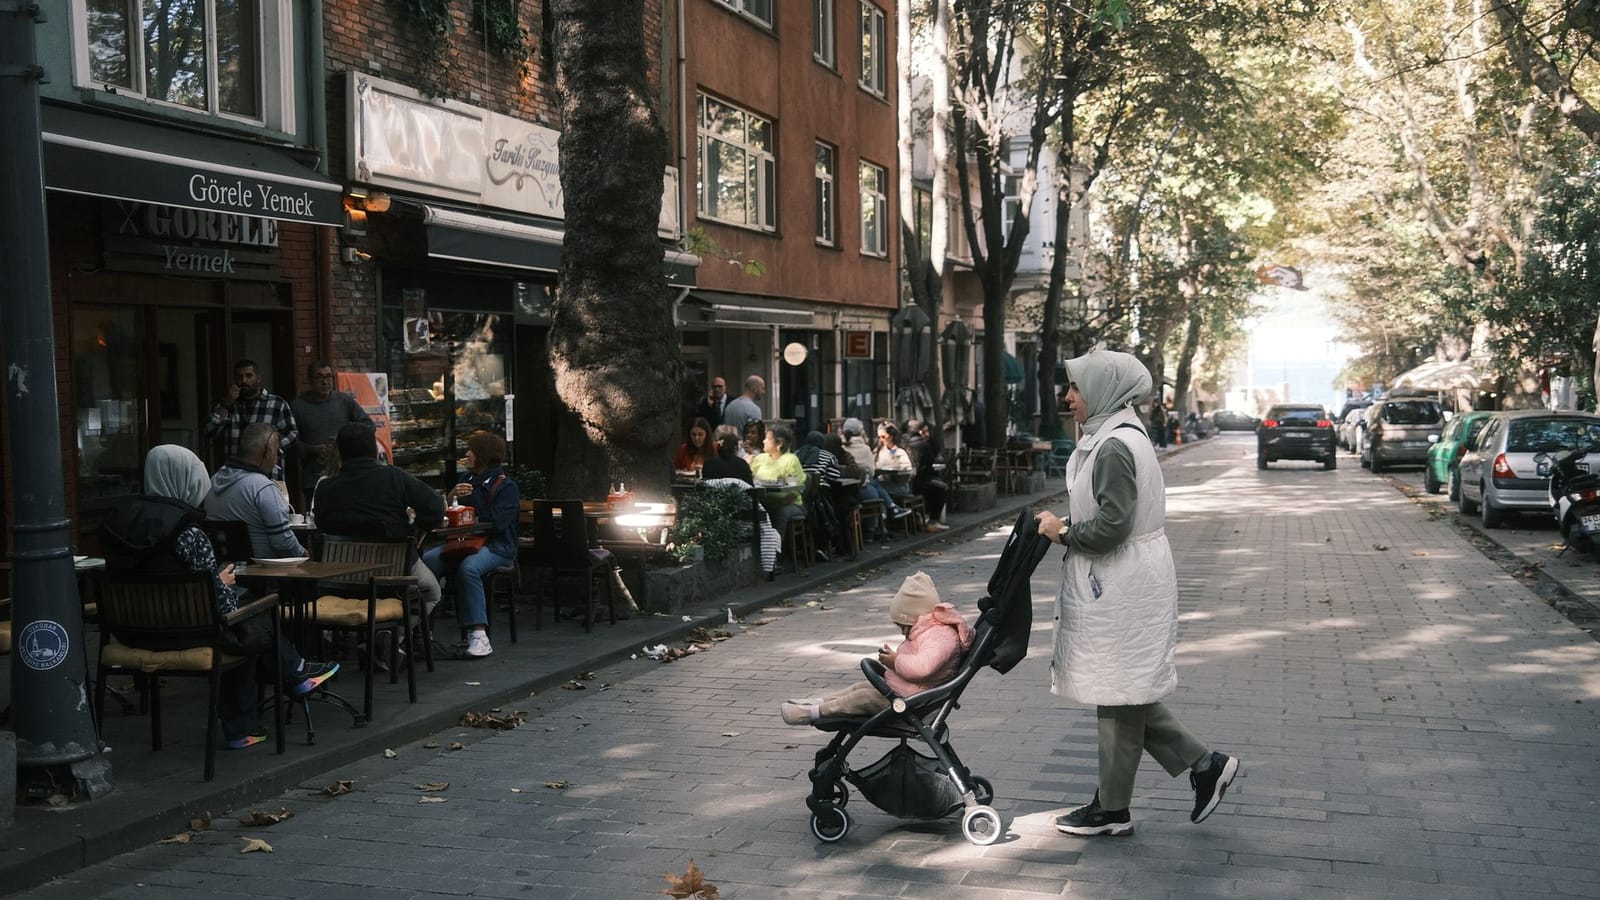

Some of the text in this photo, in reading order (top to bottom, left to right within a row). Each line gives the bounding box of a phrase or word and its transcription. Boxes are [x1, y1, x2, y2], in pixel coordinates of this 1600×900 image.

[189, 174, 313, 217] Görele Yemek
[162, 245, 236, 274] Yemek
